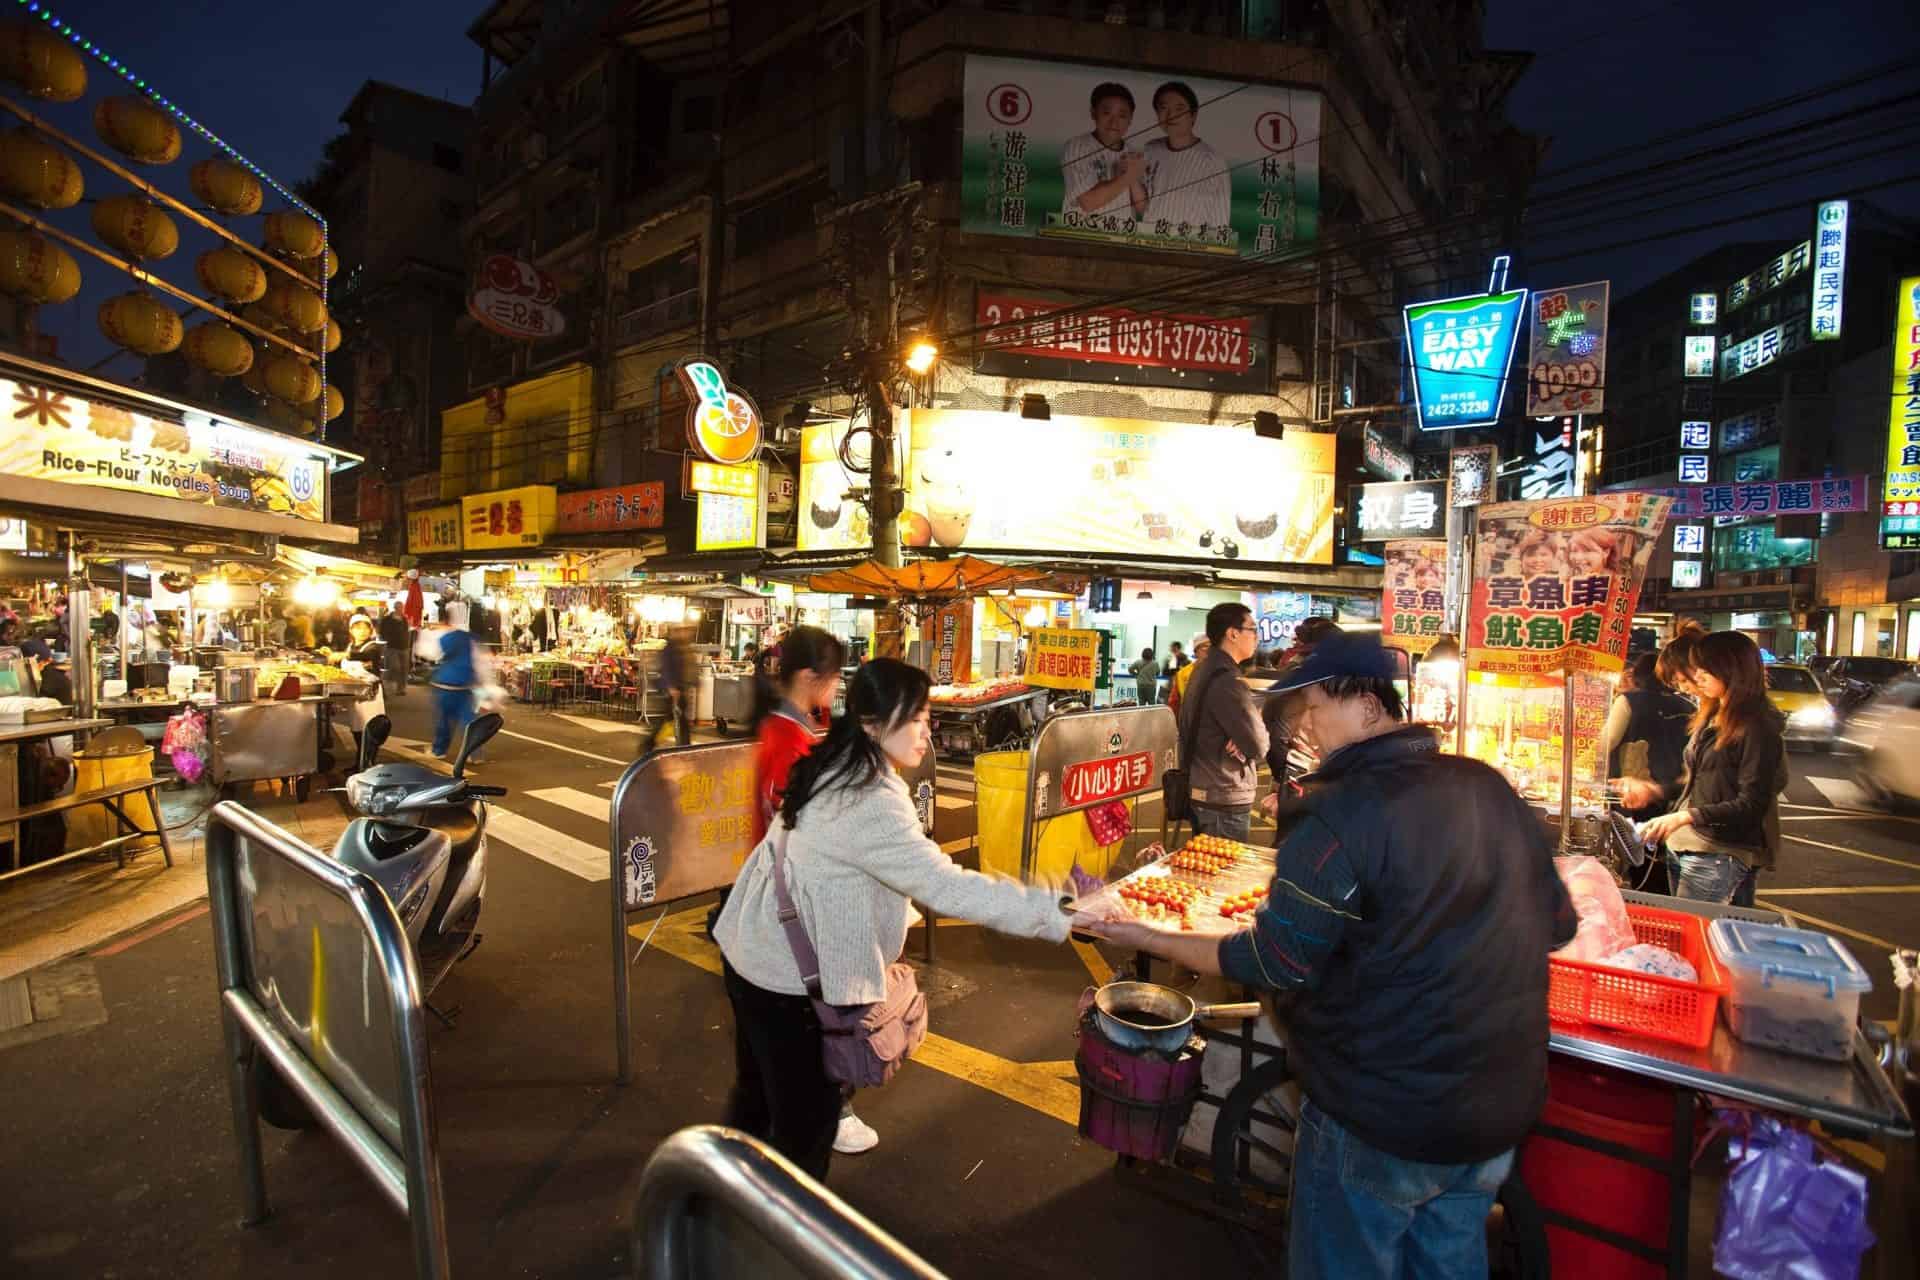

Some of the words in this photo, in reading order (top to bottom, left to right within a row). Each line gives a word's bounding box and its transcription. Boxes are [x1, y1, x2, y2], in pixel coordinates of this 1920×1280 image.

[1000, 90, 1018, 118] 6
[1269, 119, 1281, 145] 1
[1117, 317, 1241, 365] 0931-372332
[1422, 325, 1499, 353] EASY
[1427, 349, 1493, 373] WAY
[1533, 361, 1598, 402] 1000
[151, 470, 210, 494] Noodles
[218, 481, 250, 502] Soup
[1542, 504, 1597, 526] 謝記
[1487, 575, 1610, 609] 章魚串
[1619, 577, 1631, 593] 30
[1614, 599, 1628, 615] 50
[1485, 612, 1602, 648] 魷魚串
[1610, 621, 1624, 634] 40
[1070, 756, 1148, 801] 小心扒手
